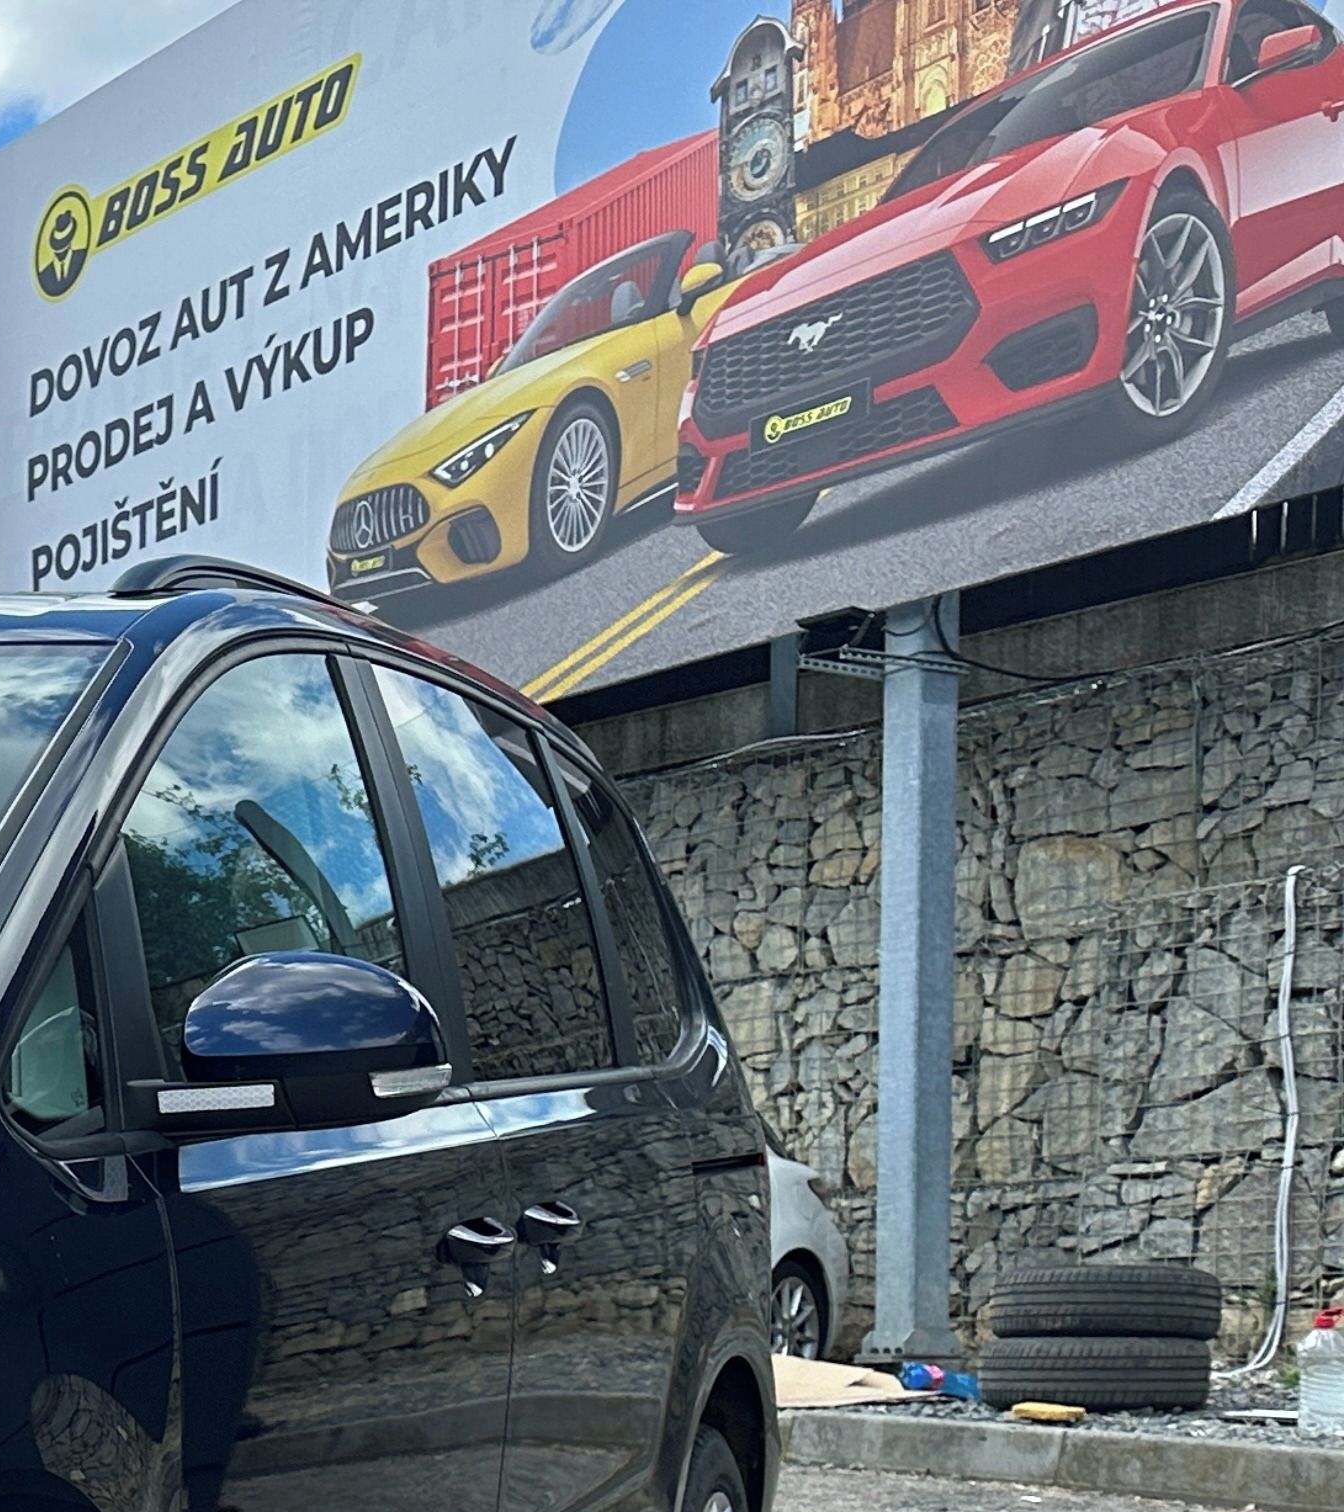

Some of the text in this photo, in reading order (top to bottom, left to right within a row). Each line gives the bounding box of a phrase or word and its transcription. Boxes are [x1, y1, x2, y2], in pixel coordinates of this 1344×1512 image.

[96, 63, 354, 248] BOSS AUTO
[29, 135, 517, 417] DOVOZ AUT Z AMERIKY
[27, 307, 374, 502] PRODEJ A VÝKUP
[31, 456, 223, 591] POJIŠTĚNÍ
